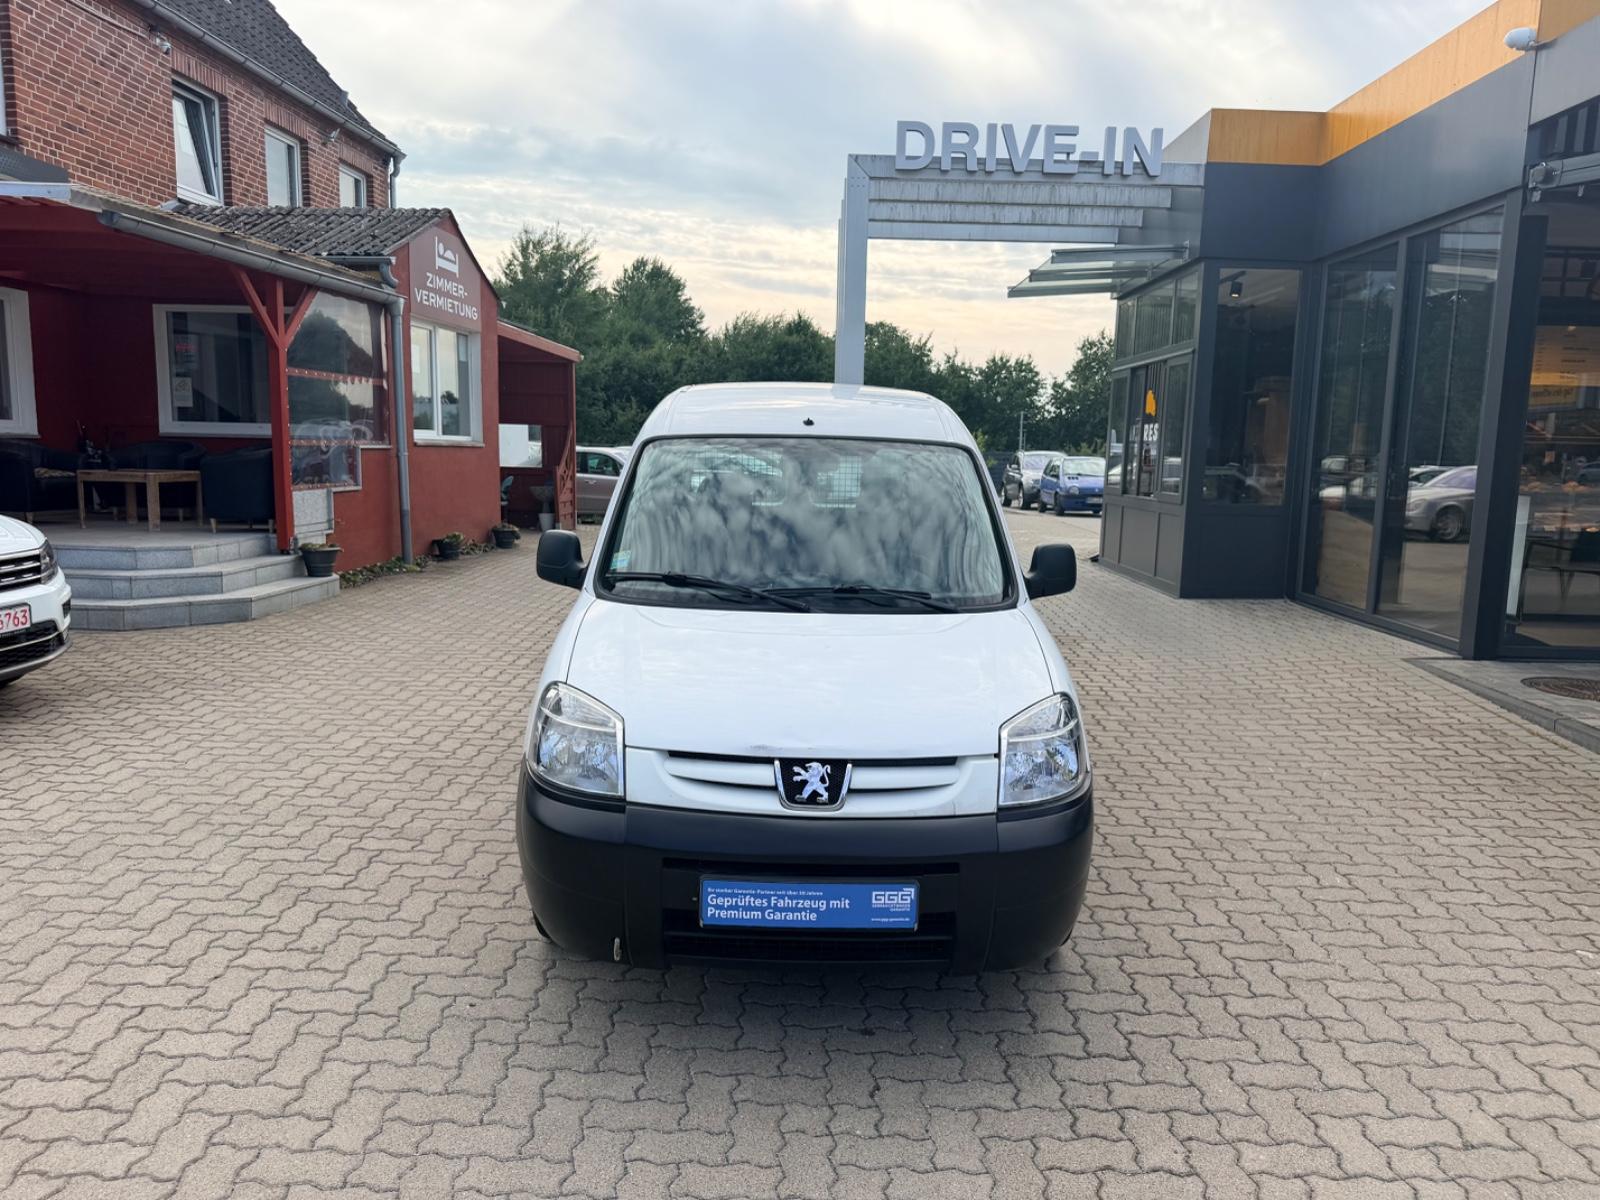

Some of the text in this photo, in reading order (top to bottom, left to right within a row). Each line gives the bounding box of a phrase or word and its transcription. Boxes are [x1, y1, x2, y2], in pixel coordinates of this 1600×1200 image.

[895, 120, 1164, 177] DRIVE-IN
[426, 272, 468, 299] ZIMMER-
[415, 287, 478, 320] VERMIETUNG
[708, 894, 850, 911] Geprüftes Fahrzeug mit
[872, 891, 911, 904] GGG
[708, 907, 817, 921] Premium Garantie
